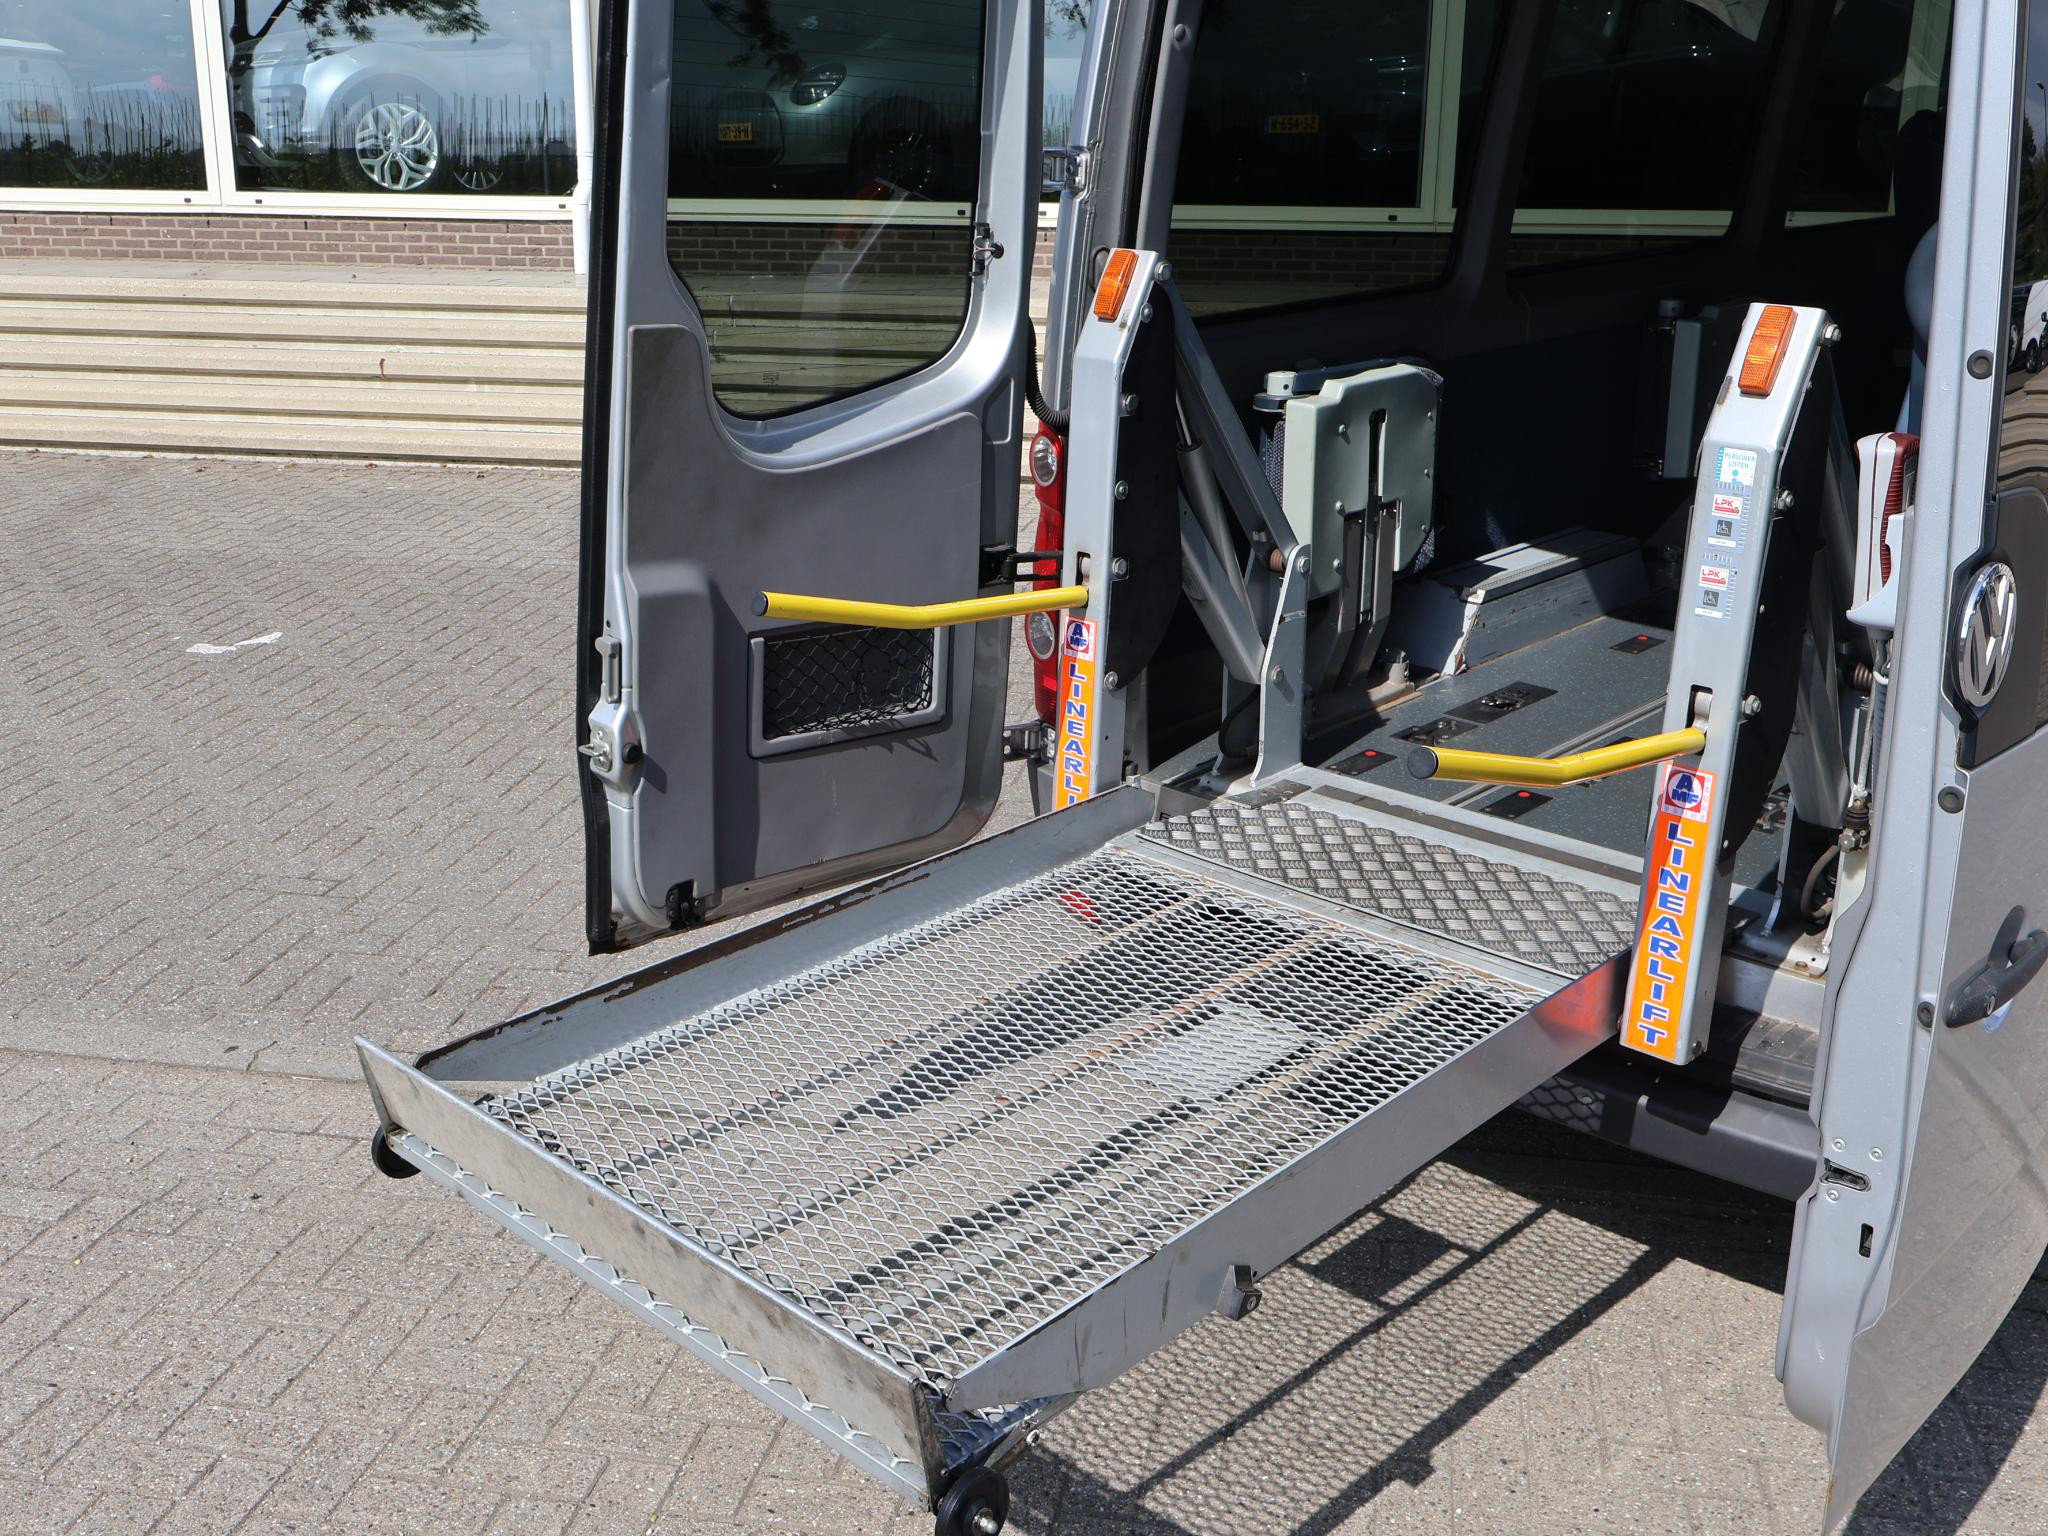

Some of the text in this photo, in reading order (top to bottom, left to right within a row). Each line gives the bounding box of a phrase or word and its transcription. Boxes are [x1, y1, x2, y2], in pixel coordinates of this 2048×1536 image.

[1714, 498, 1734, 508] LPK
[1701, 569, 1721, 579] LPK
[1637, 821, 1695, 1046] LINEARLIFT
